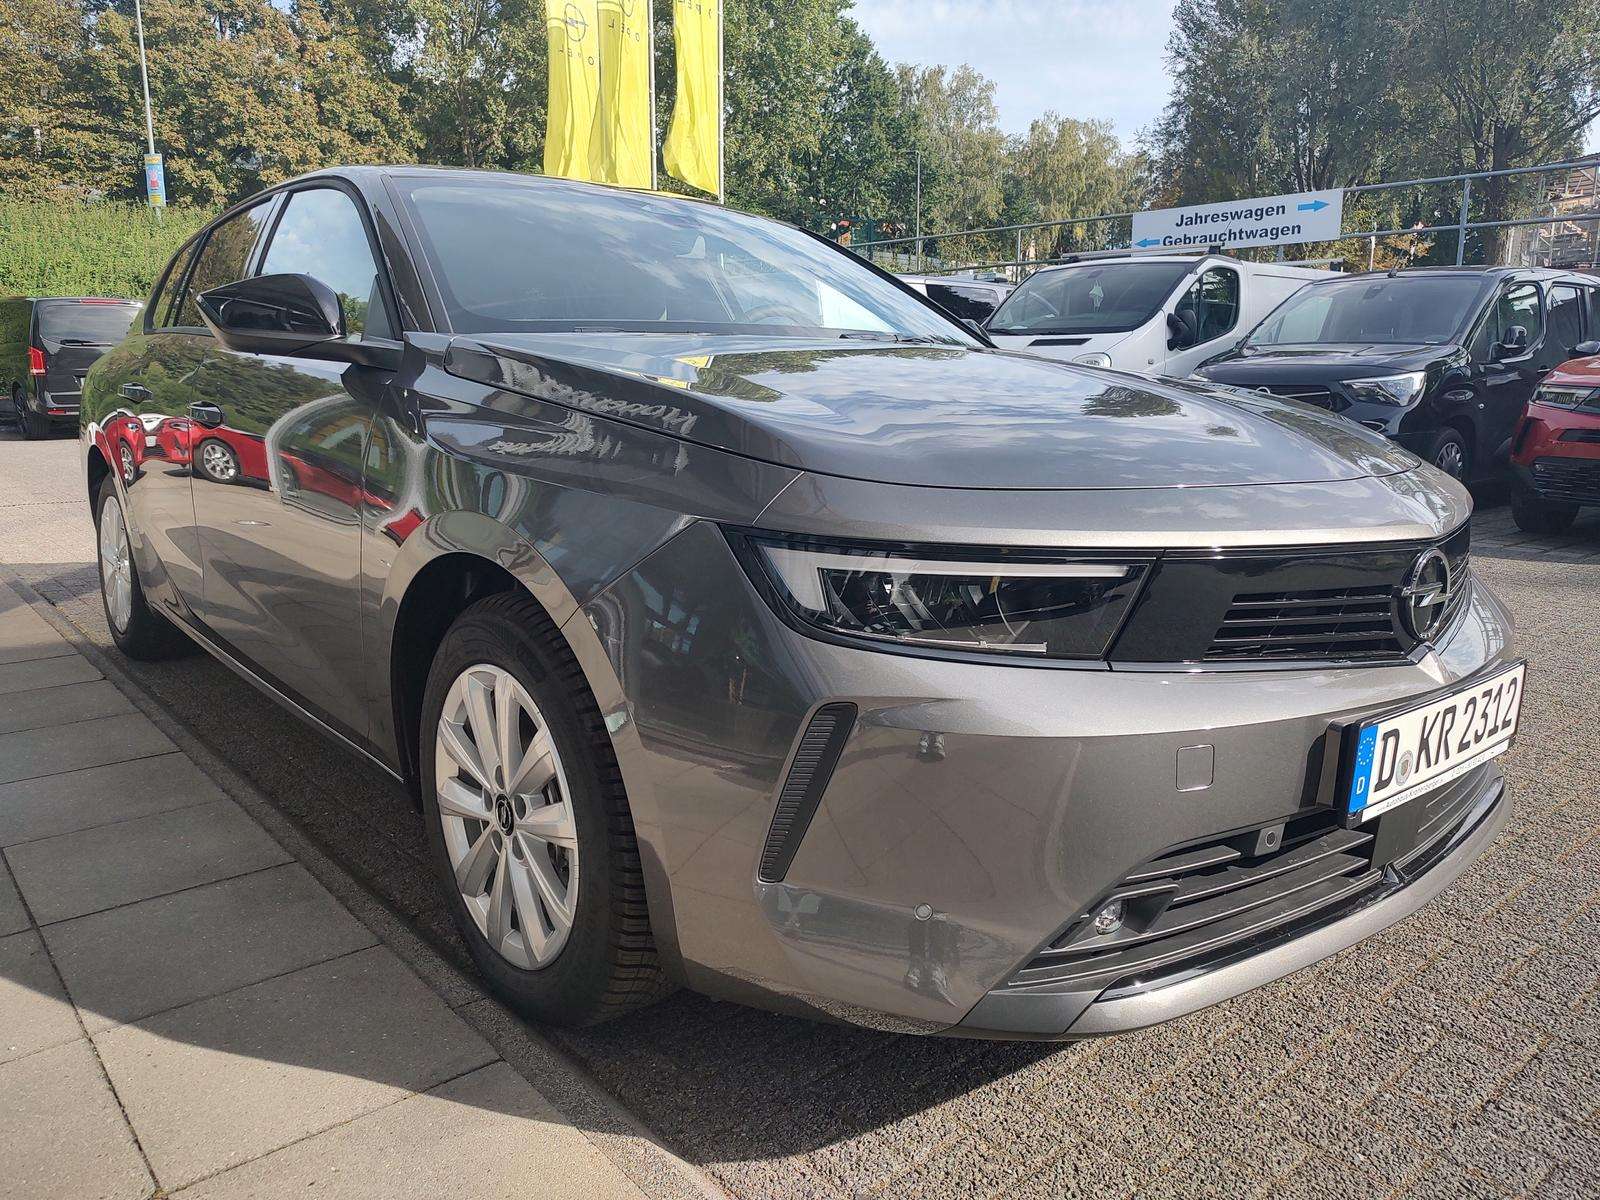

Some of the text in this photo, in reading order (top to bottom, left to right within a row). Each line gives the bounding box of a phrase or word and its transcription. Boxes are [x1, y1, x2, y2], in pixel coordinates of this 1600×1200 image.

[1175, 203, 1286, 228] Jahreswagen
[1162, 223, 1302, 247] Gebrauchtwagen
[1374, 728, 1401, 793] D
[1415, 704, 1457, 774] KR
[1457, 676, 1518, 754] 2312
[1356, 776, 1365, 795] D
